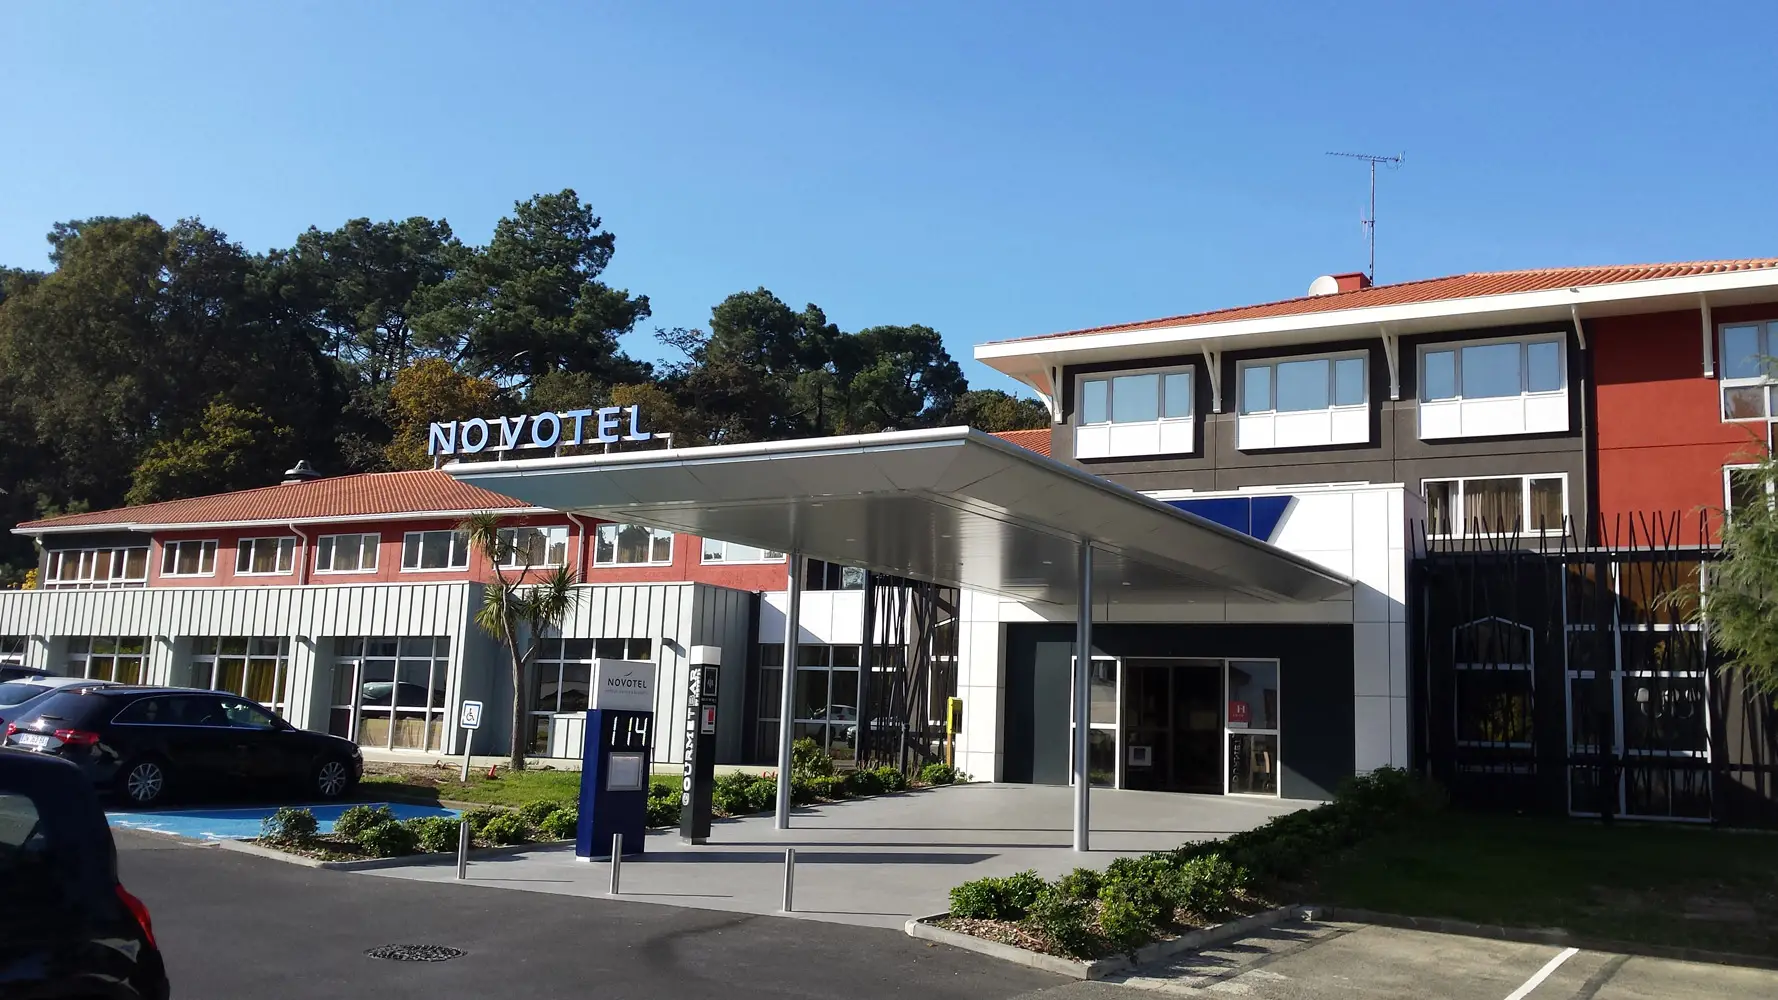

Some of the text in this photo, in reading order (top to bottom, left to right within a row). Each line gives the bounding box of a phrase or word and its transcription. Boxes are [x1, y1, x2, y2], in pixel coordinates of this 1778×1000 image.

[428, 404, 653, 456] NOVOTEL
[607, 678, 647, 689] NOVOTEL
[1237, 705, 1246, 714] H
